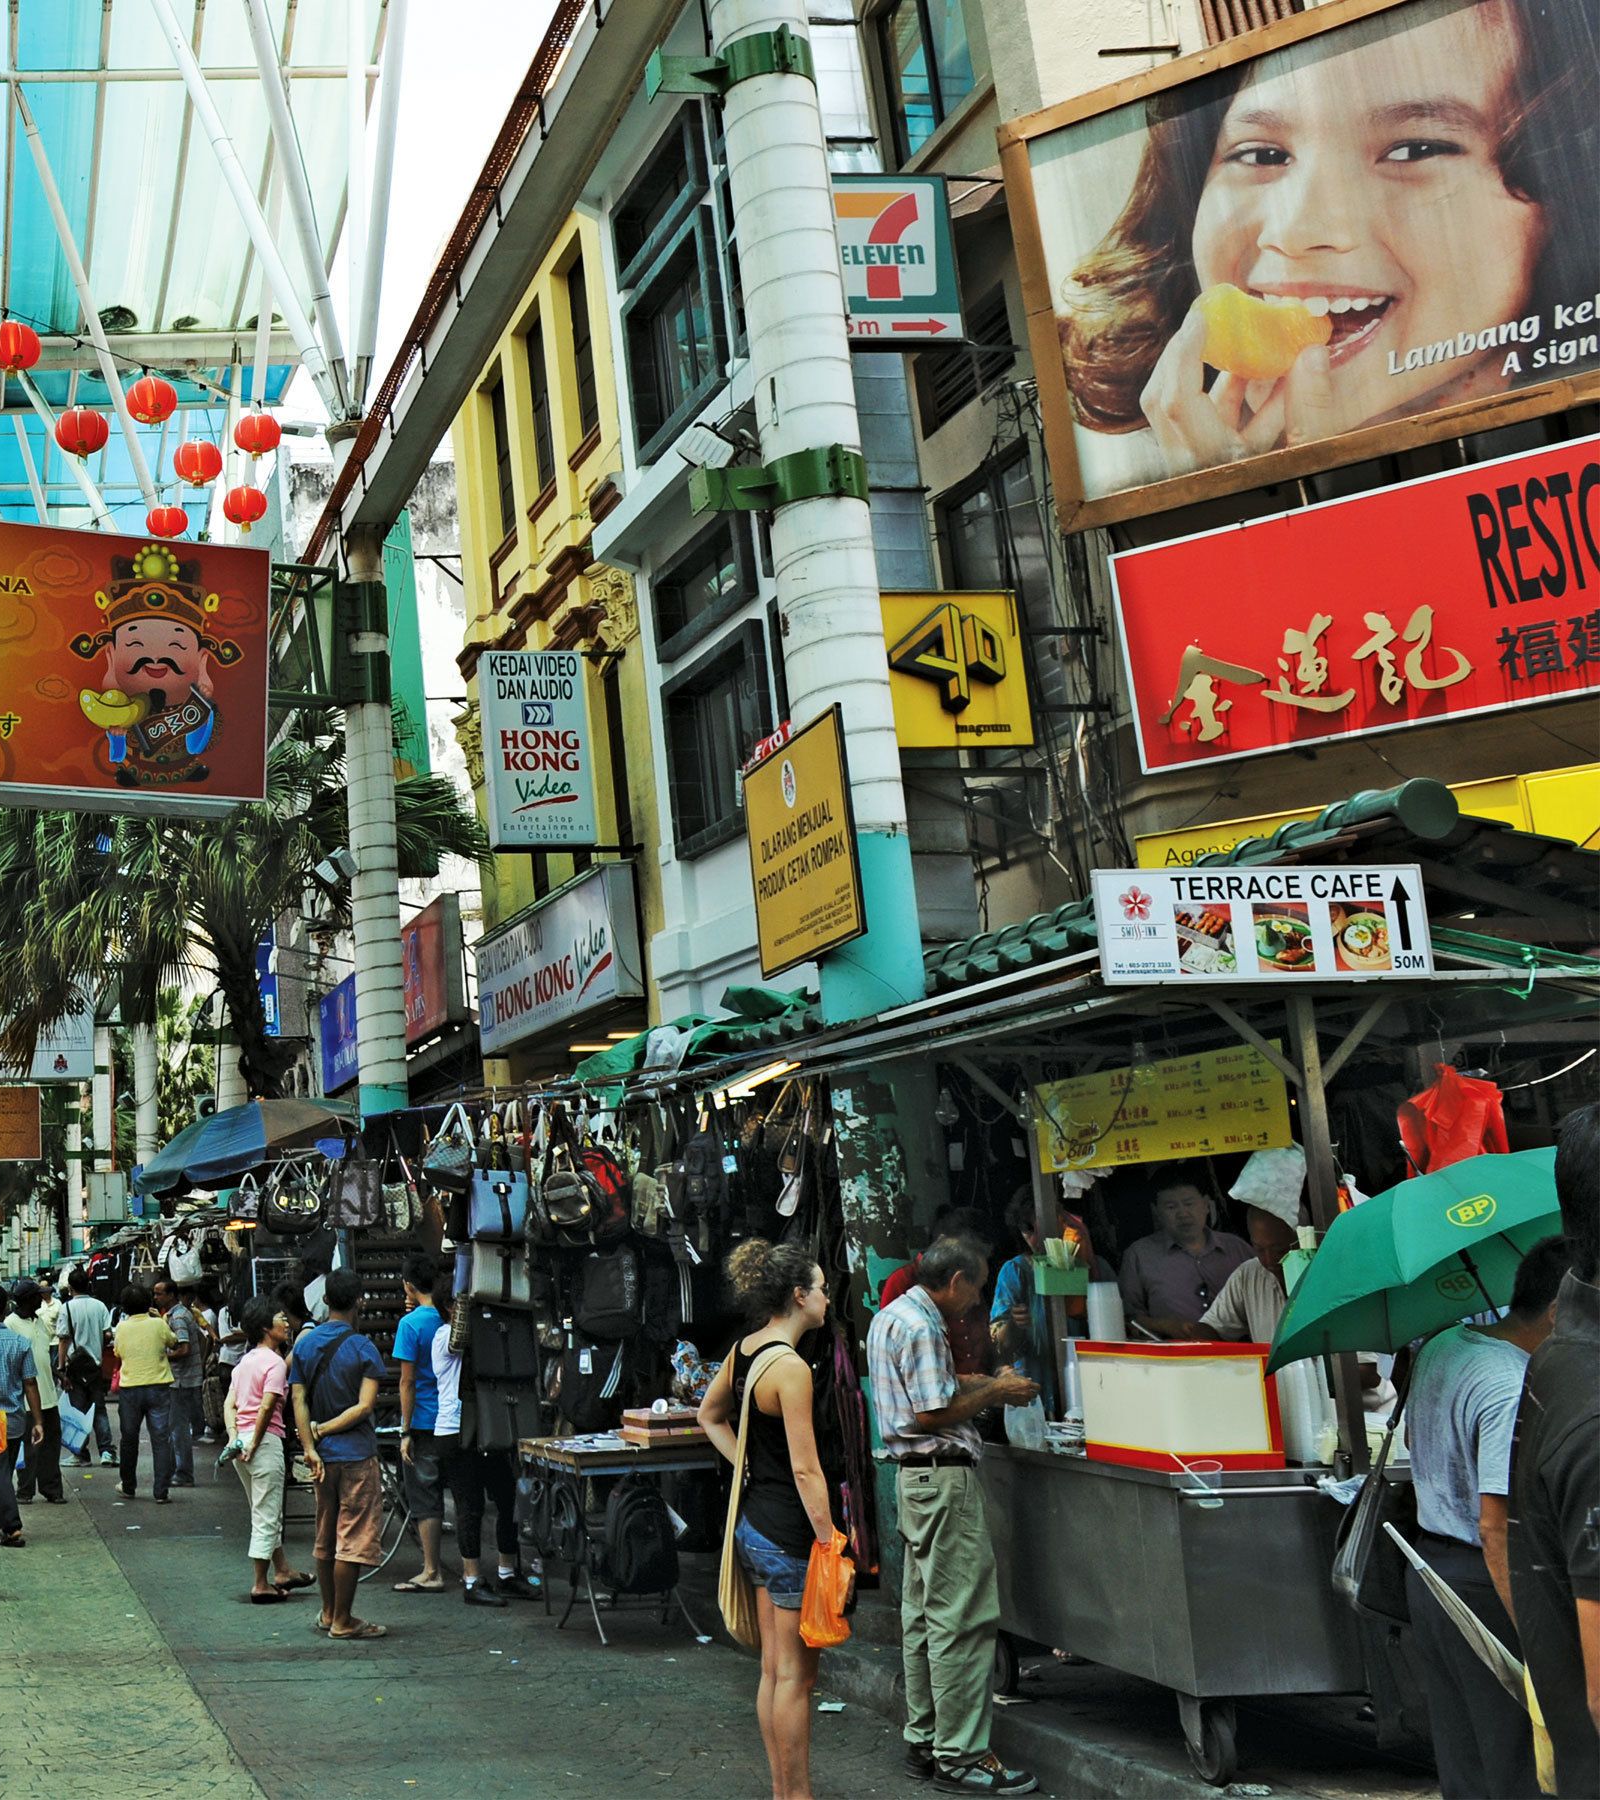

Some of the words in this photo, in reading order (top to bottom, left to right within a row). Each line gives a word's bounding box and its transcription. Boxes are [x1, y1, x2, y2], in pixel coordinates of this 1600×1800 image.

[1386, 314, 1541, 376] Lambang
[1500, 351, 1522, 377] A
[489, 655, 531, 677] KEDAI
[535, 655, 577, 677] VIDEO
[497, 679, 526, 700] DAN
[530, 679, 574, 700] AUDIO
[500, 729, 580, 751] HONG
[956, 723, 1011, 737] magnum
[503, 751, 580, 772] KONG
[515, 773, 572, 803] Video
[503, 823, 590, 831] Entertainment
[519, 815, 540, 823] One
[548, 815, 574, 824] Stop
[760, 820, 799, 864] DILARANG
[797, 797, 834, 841] MENJUAL
[527, 831, 568, 840] Choice
[758, 864, 786, 903] PRODUK
[786, 850, 811, 884] CETAK
[810, 829, 846, 874] ROMPAK
[1170, 874, 1303, 901] TERRACE
[1310, 873, 1384, 899] CAFE
[495, 976, 532, 1024] HONG
[533, 954, 575, 1006] KONG
[575, 919, 606, 985] Video
[1394, 955, 1425, 970] 50M
[1456, 1199, 1490, 1223] BP
